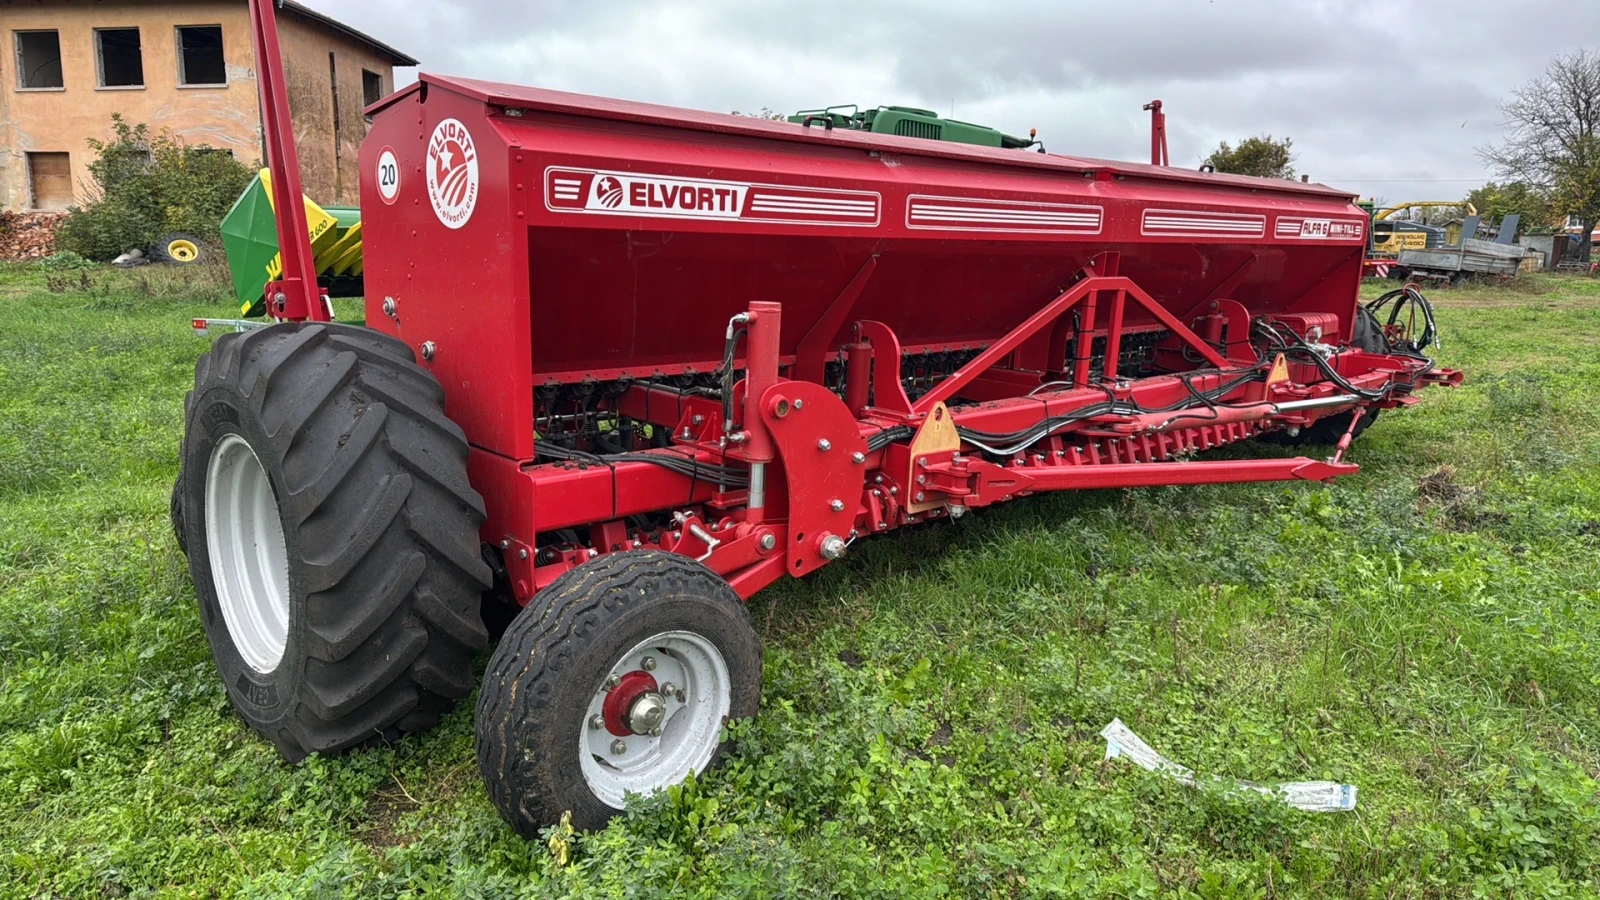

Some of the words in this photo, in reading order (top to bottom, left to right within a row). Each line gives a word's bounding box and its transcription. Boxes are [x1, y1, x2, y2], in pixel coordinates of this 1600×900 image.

[430, 123, 474, 163] ELVORTI
[381, 164, 396, 185] 20
[430, 179, 475, 223] www.elvorti.com
[629, 182, 737, 212] ELVORTI
[314, 220, 328, 236] 600
[1303, 222, 1321, 235] ALFA
